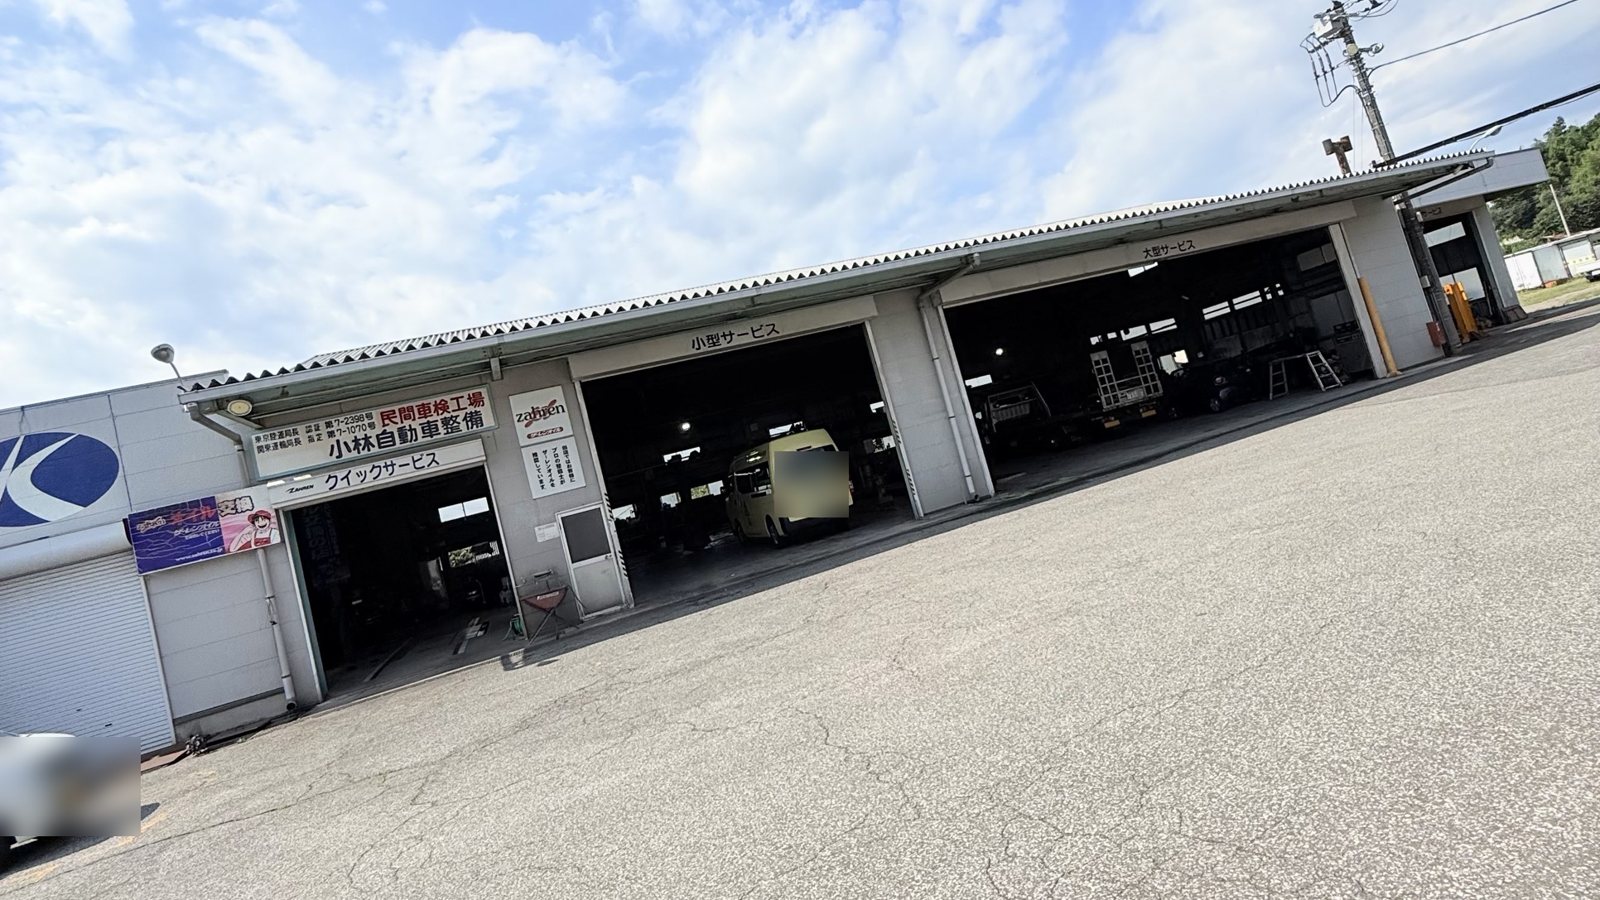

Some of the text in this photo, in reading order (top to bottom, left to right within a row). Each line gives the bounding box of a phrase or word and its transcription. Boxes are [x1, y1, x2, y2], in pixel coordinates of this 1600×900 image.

[1143, 240, 1196, 259] 大型サービス
[691, 323, 780, 351] 小型サービス
[380, 391, 485, 428] 民間車検工場
[329, 410, 485, 460] 小林自動車整備
[325, 451, 440, 491] クイックサービス
